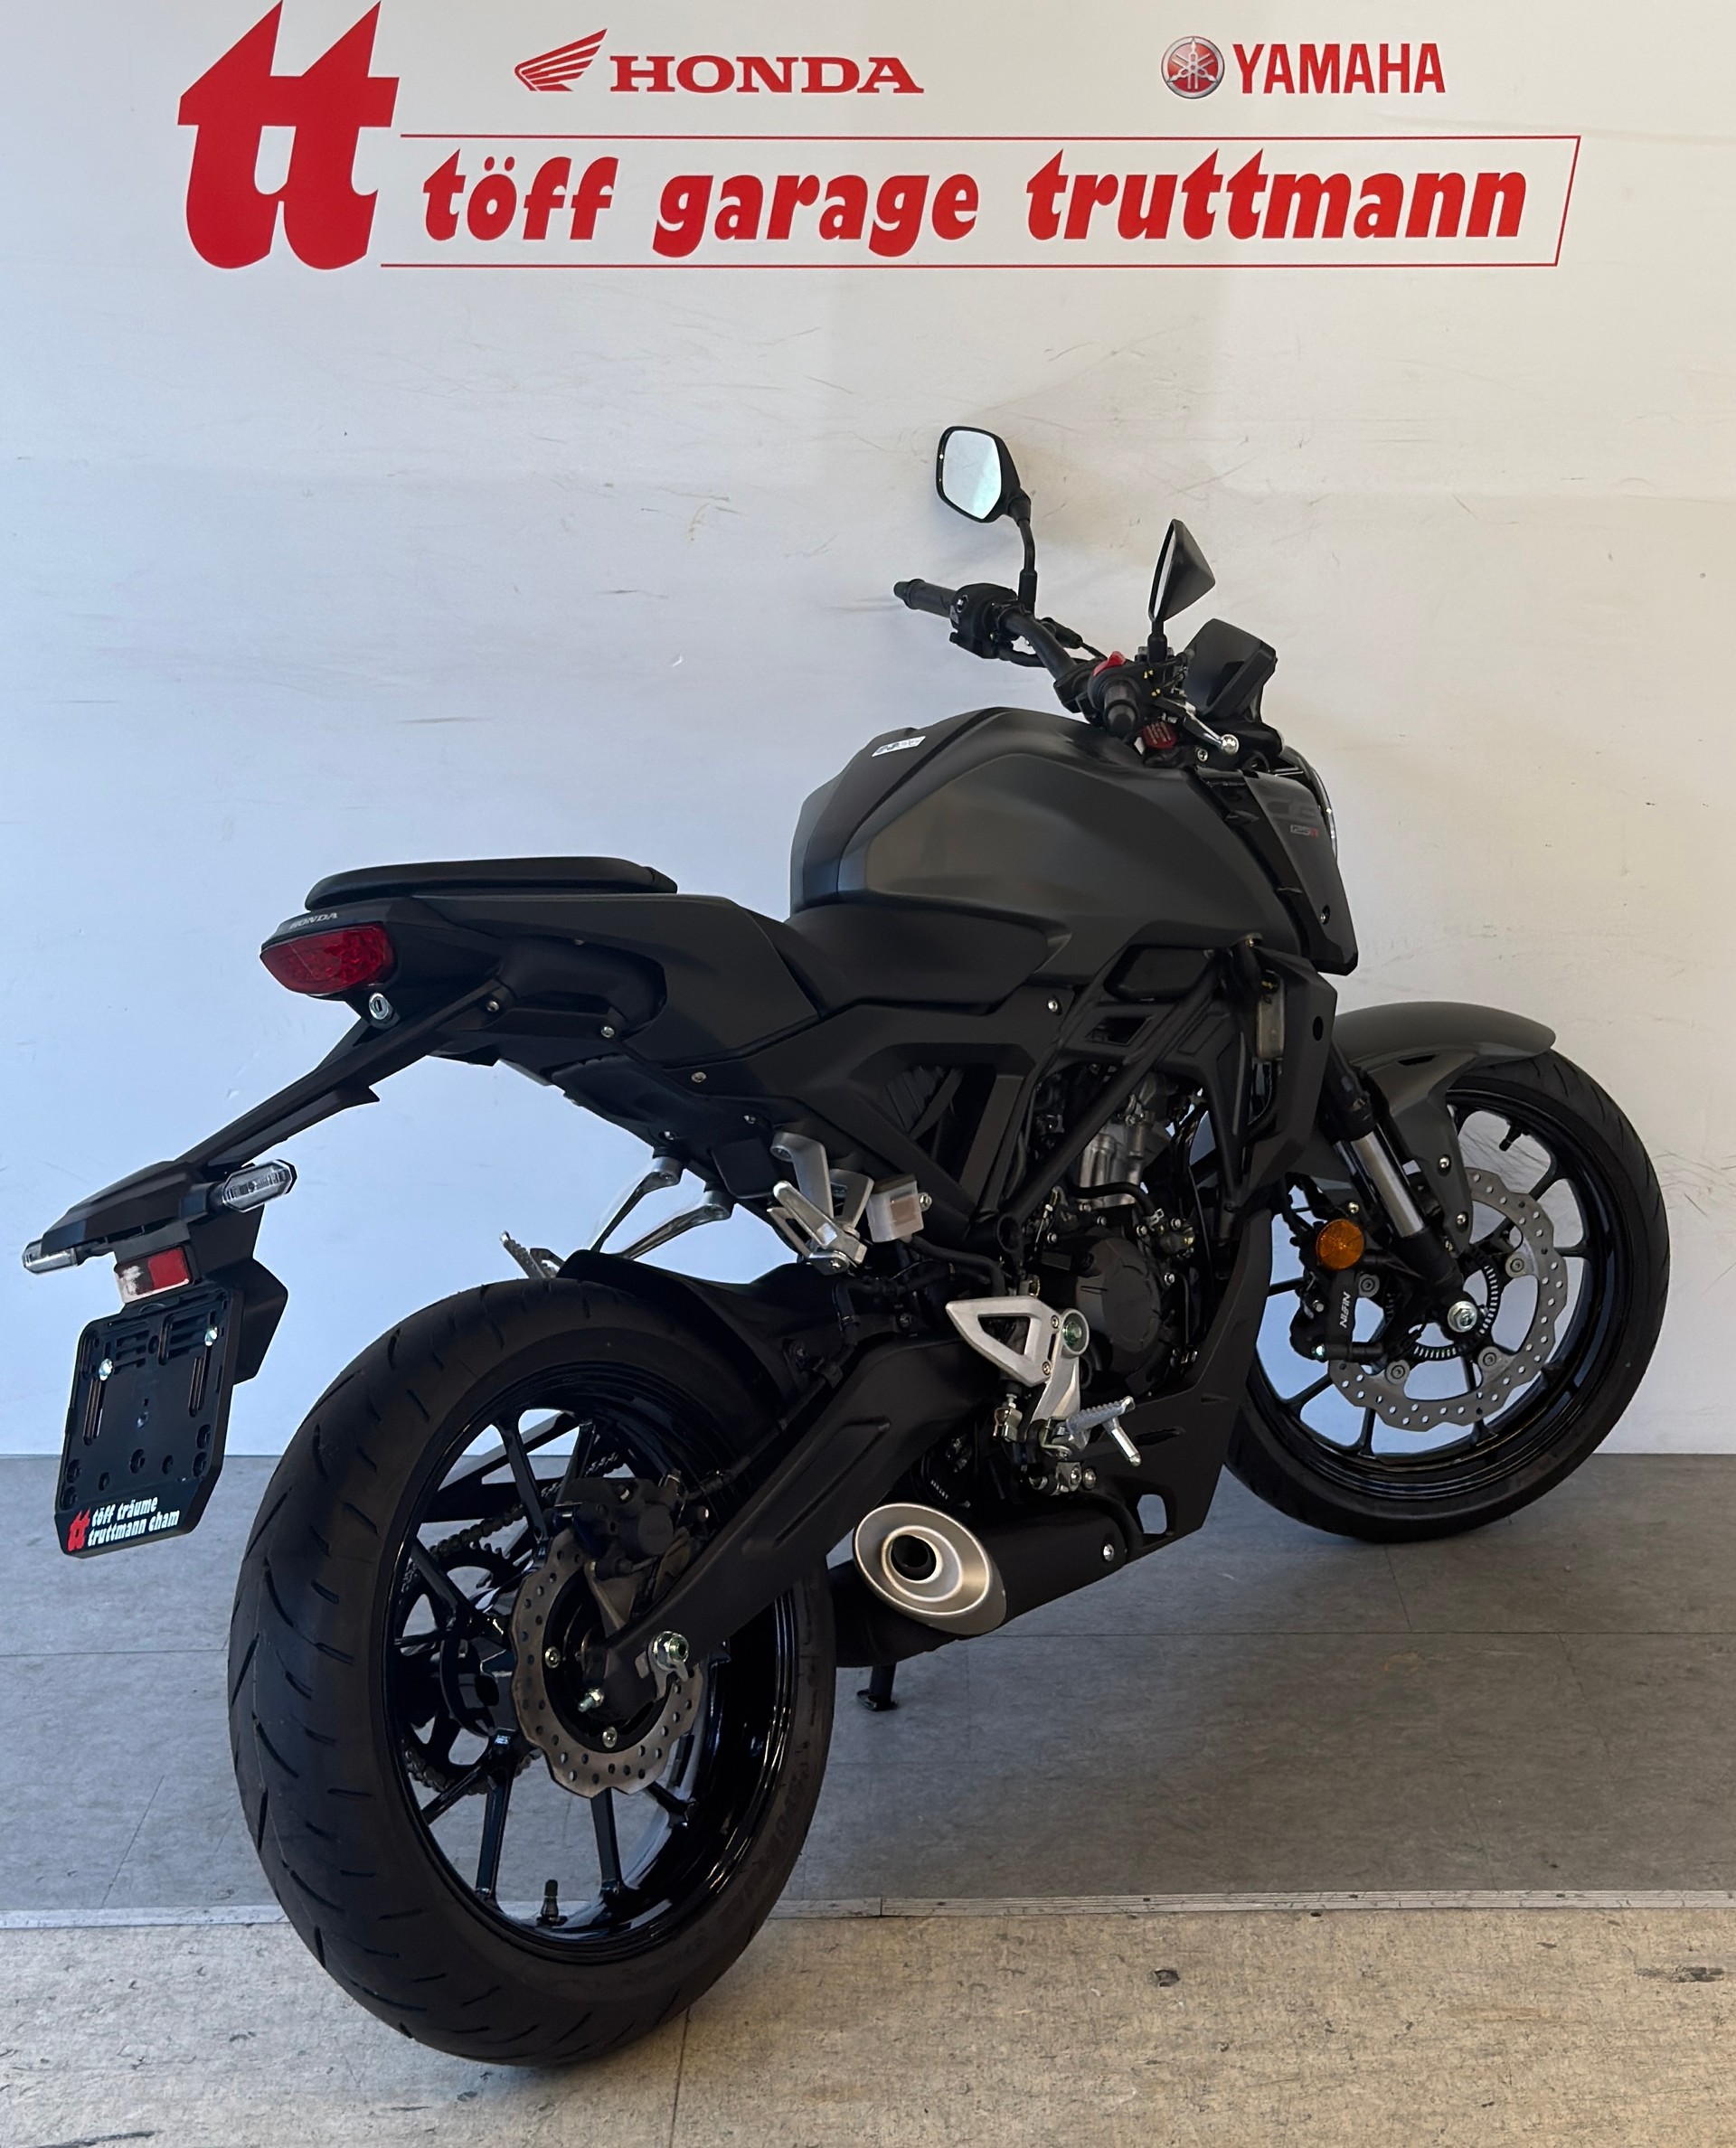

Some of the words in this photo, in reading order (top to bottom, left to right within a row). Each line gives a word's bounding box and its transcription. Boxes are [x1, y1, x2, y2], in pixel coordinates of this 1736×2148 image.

[609, 55, 924, 94] HONDA
[1232, 42, 1446, 94] YAMAHA
[423, 150, 618, 241] töff
[652, 174, 979, 259] garage
[1026, 150, 1527, 240] truttmann
[288, 912, 338, 929] HONDA
[91, 1503, 116, 1527] töff
[117, 1496, 158, 1521] träume
[87, 1518, 146, 1547] truttmann
